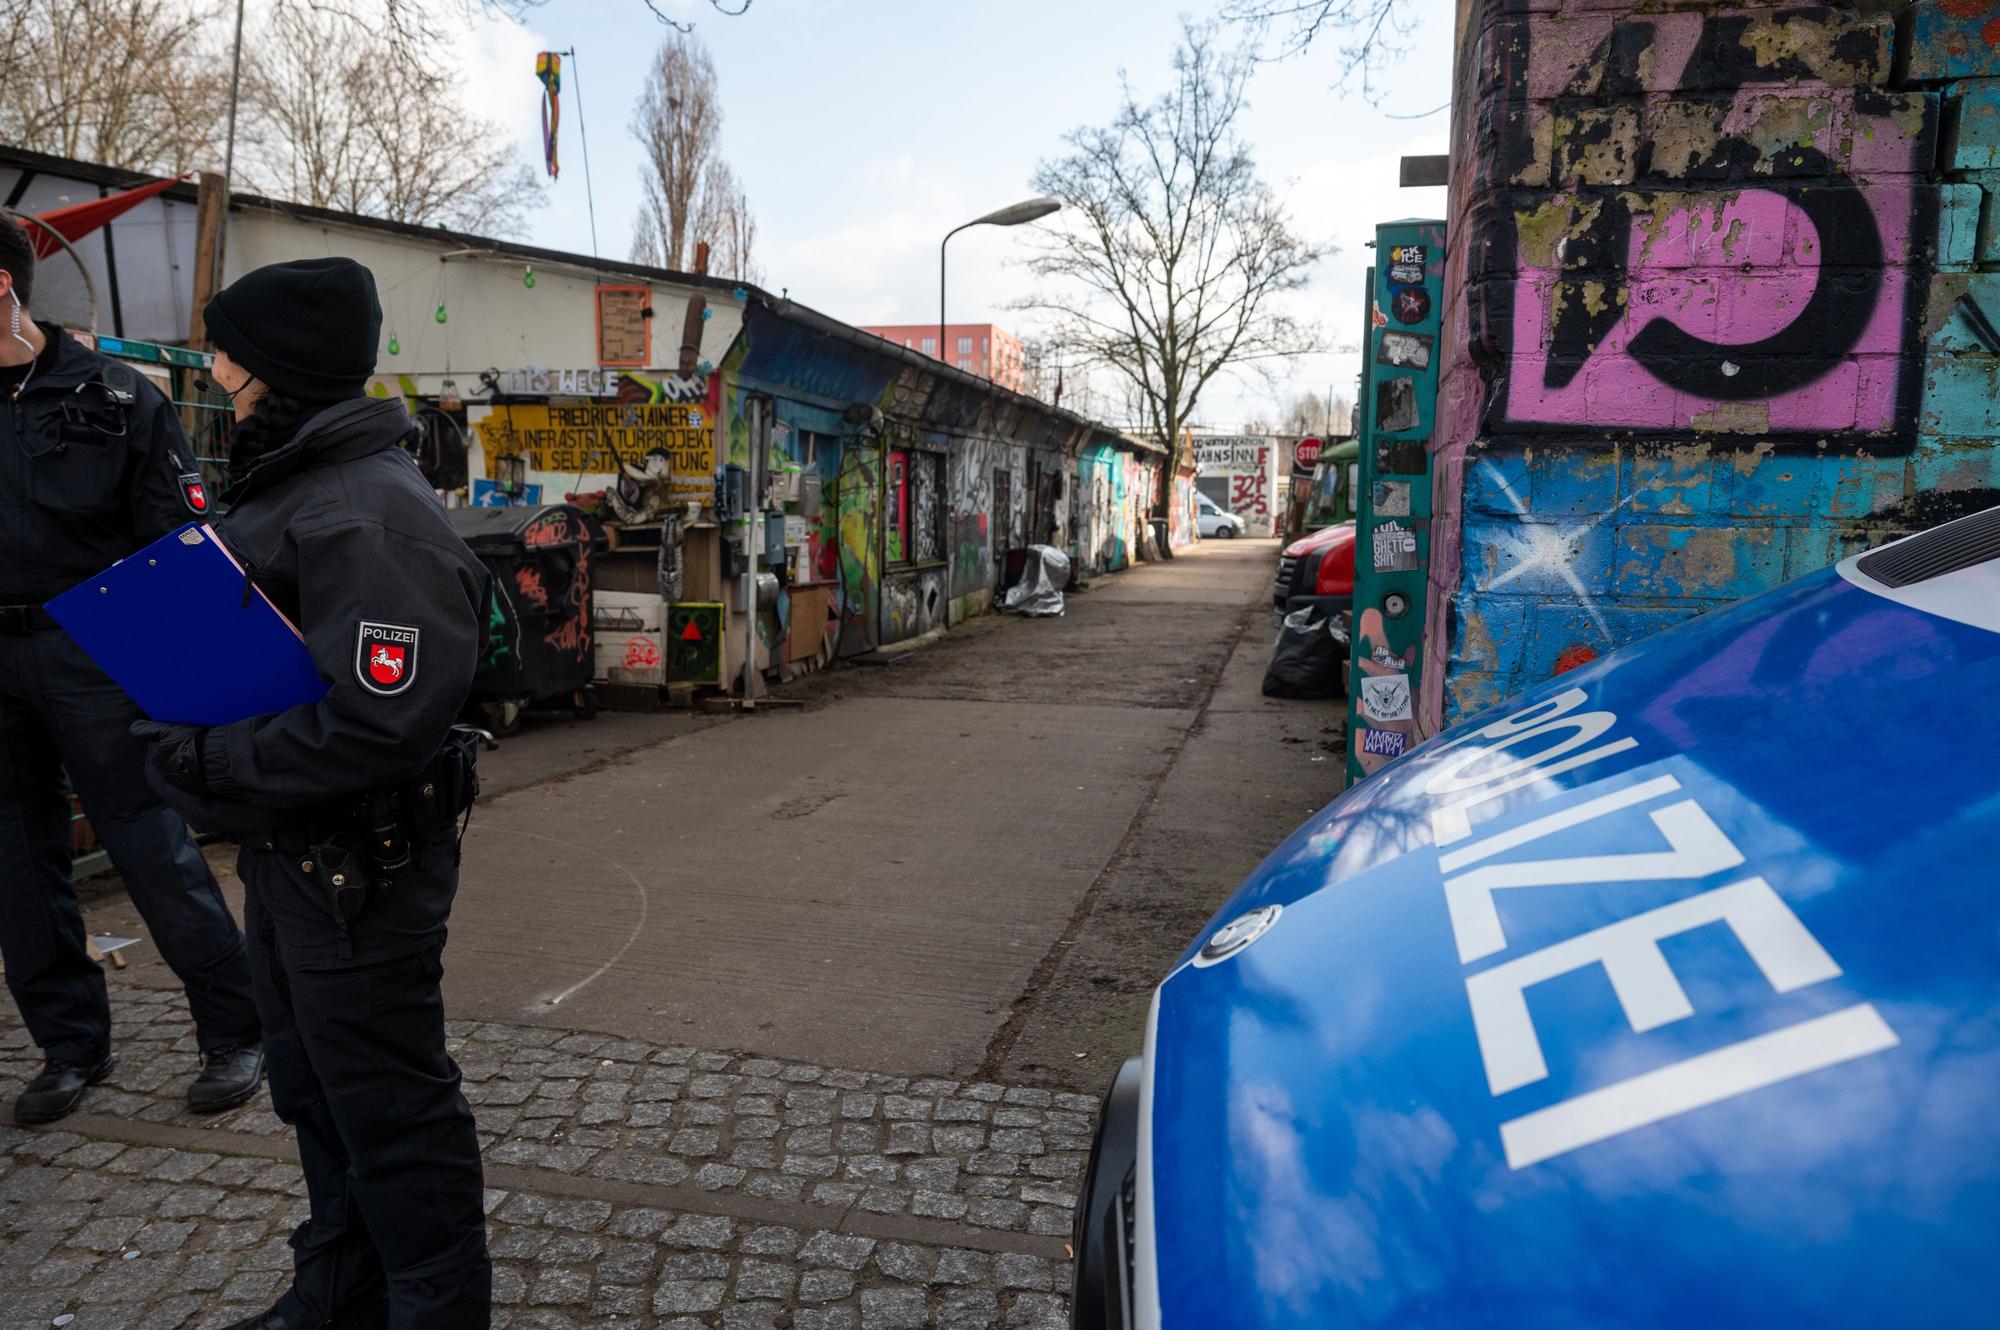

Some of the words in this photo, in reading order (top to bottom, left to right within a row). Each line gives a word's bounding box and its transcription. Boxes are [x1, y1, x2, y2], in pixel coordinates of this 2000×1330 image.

[1401, 255, 1423, 263] ICE
[549, 406, 689, 428] FRIEDRICHHAINER
[530, 451, 542, 470] IN
[1298, 446, 1318, 460] STO
[1374, 553, 1394, 567] SHIT
[363, 627, 415, 643] POLIZEI
[1424, 687, 1900, 1171] POLIZEI
